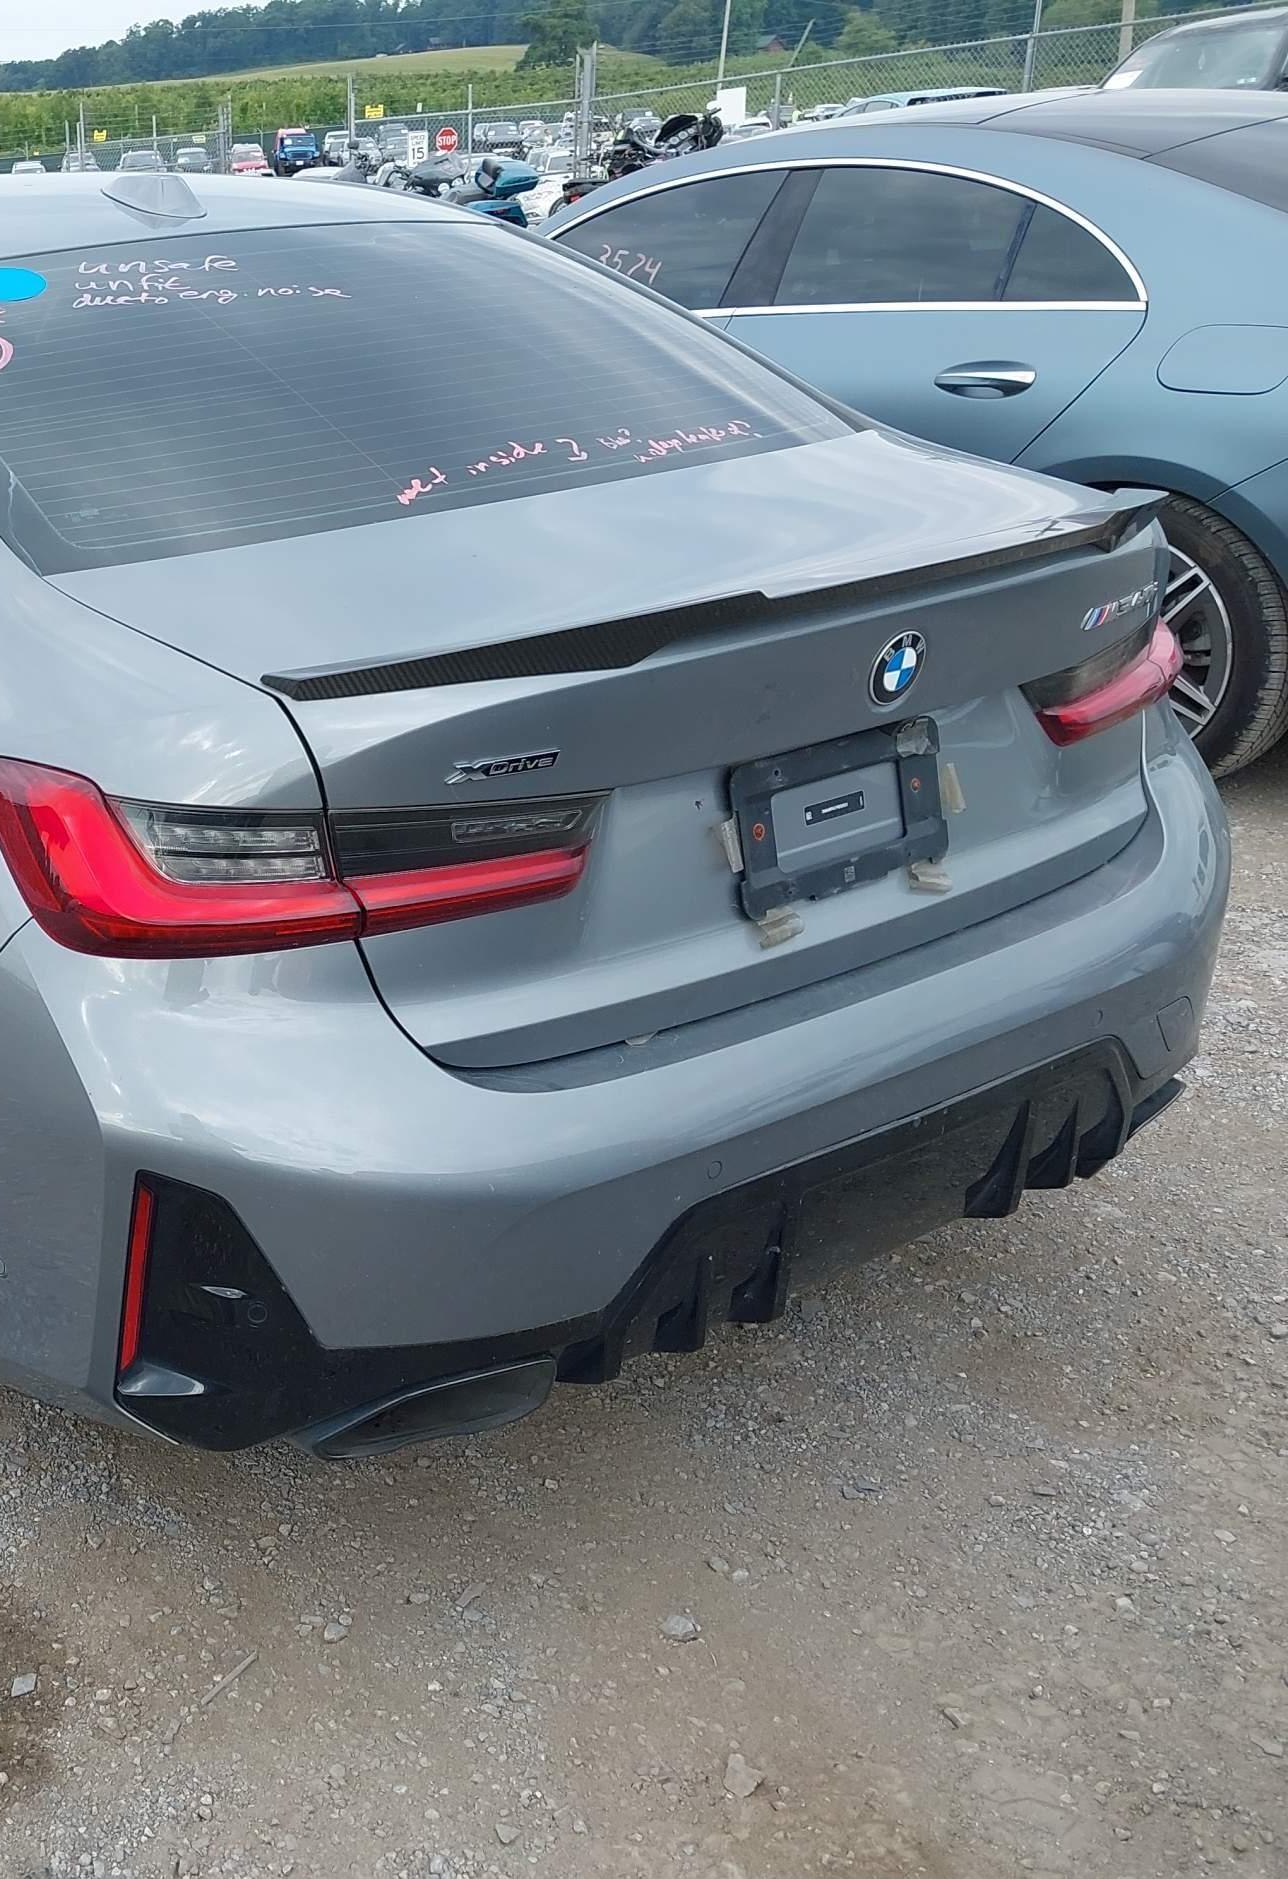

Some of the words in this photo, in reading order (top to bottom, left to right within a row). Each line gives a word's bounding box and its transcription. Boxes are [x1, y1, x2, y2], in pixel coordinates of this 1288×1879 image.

[438, 135, 457, 146] STOP
[412, 147, 425, 160] 15
[78, 255, 239, 274] unsafe
[466, 441, 548, 475] inside
[883, 633, 926, 662] BMW
